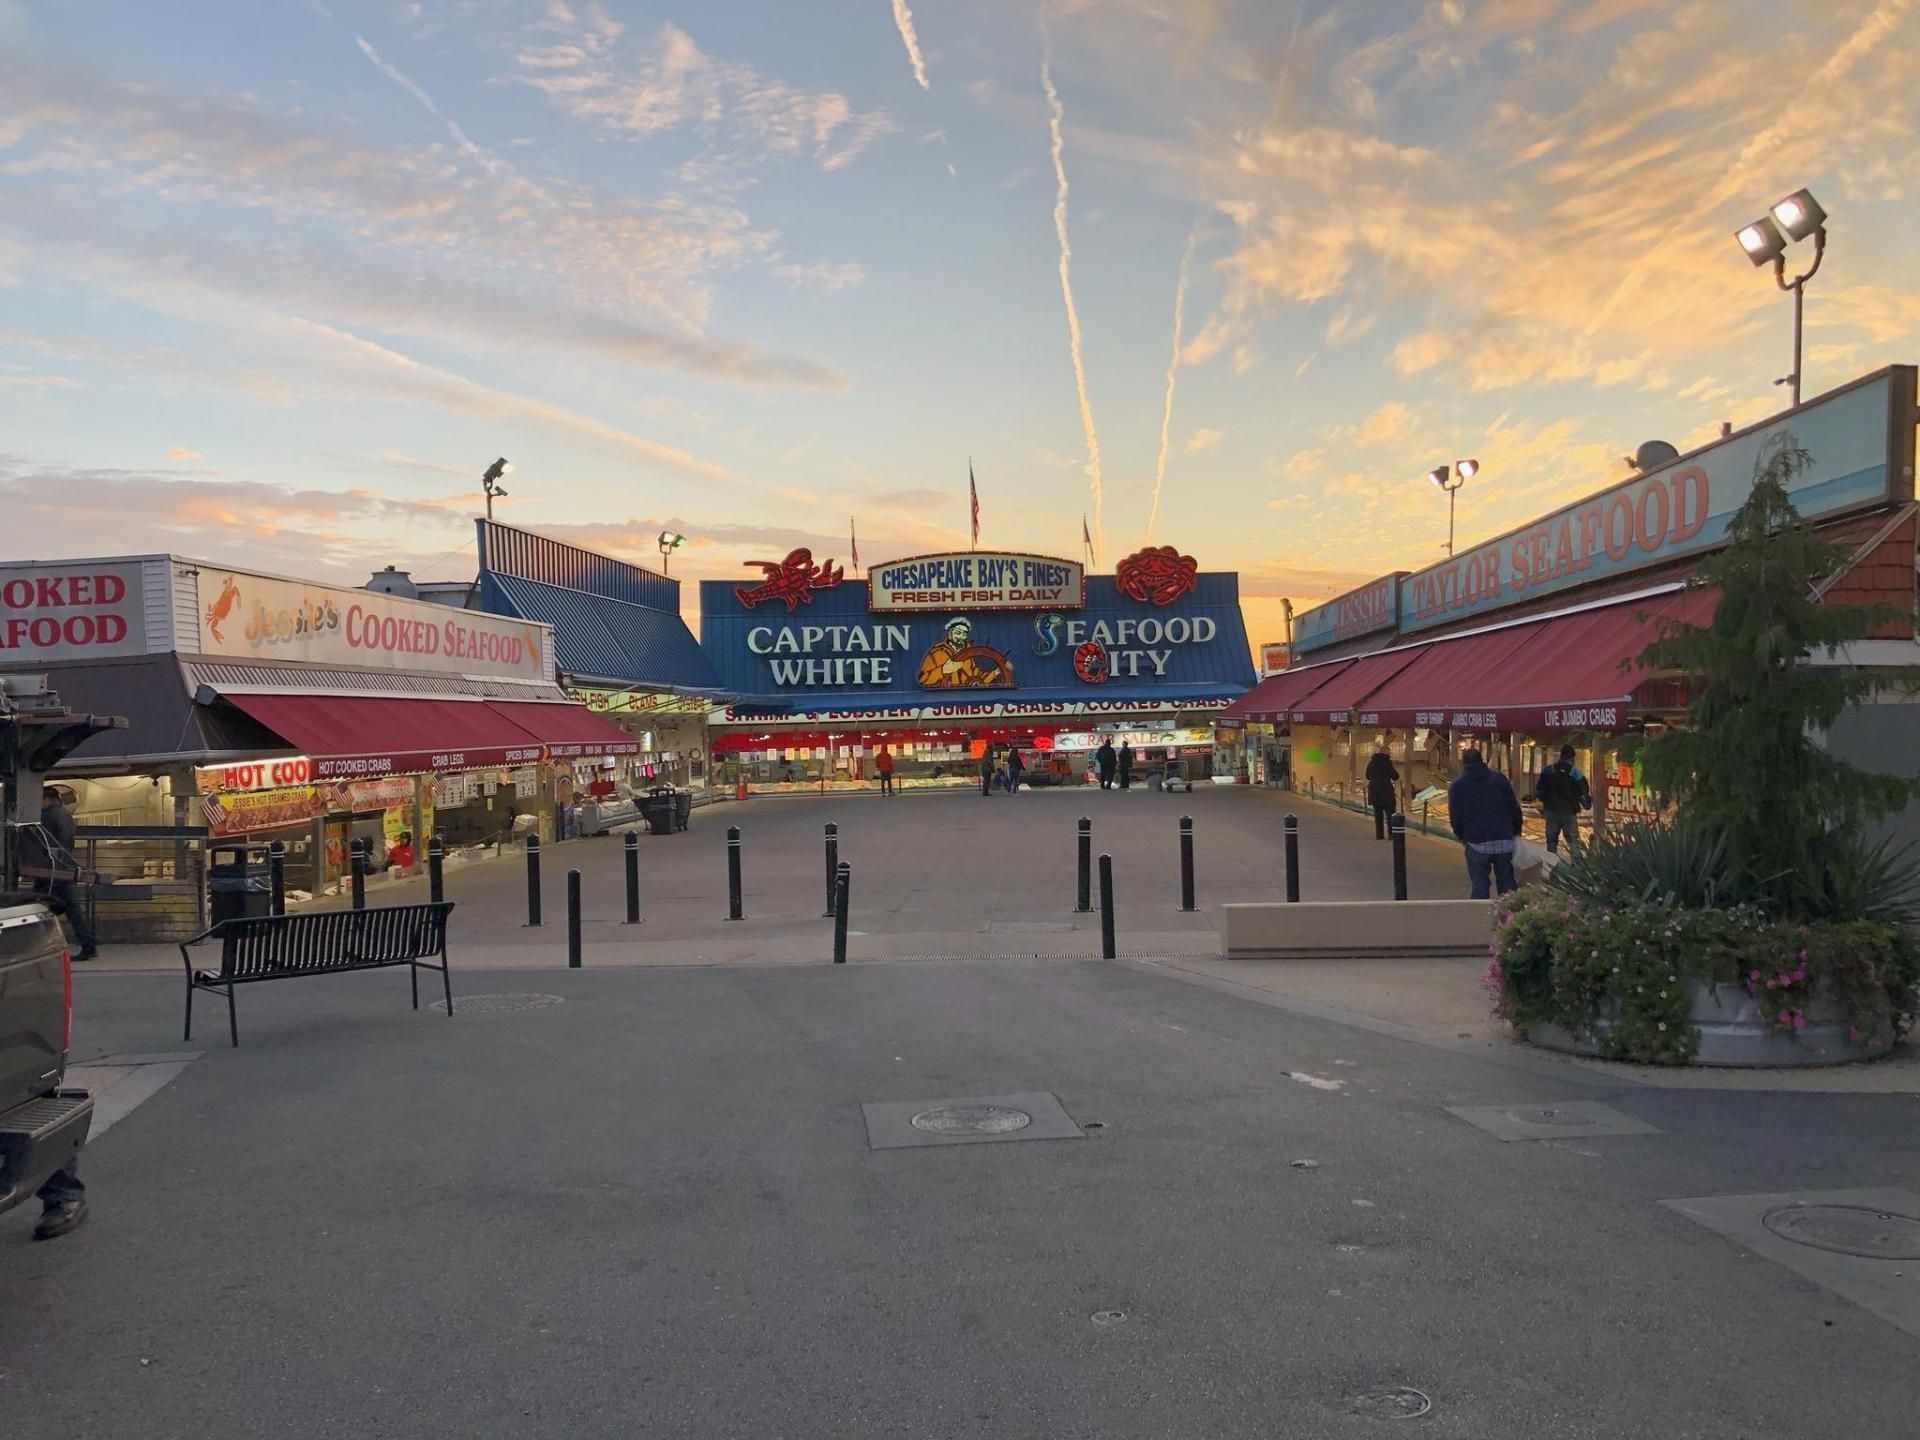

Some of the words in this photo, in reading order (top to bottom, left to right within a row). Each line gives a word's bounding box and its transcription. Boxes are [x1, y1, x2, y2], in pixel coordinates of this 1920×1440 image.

[1412, 548, 1500, 620] TAYLOR
[1510, 465, 1709, 592] SEAFOOD
[881, 560, 973, 590] CHESAPEAKE
[978, 559, 1018, 588] BAY'S
[1023, 561, 1071, 587] FINEST
[0, 575, 126, 609] OKED
[891, 591, 955, 603] FRESH
[960, 590, 1003, 602] FISH
[1008, 588, 1062, 601] DAILY
[1335, 586, 1387, 637] JESSIE
[443, 620, 522, 665] SEAFOOD
[746, 624, 911, 654] CAPTAIN
[769, 657, 893, 686] WHITE
[590, 692, 609, 709] FISH
[629, 695, 658, 710] CLAMS
[932, 703, 995, 717] JUMBO
[1004, 702, 1065, 714] CRABS
[1544, 711, 1560, 726] LIVE
[1561, 709, 1587, 726] JUMBO
[1589, 707, 1617, 726] CRABS
[1451, 713, 1468, 727] JUMBO
[1468, 713, 1483, 727] CRAB
[1483, 713, 1497, 728] LEGS
[1077, 732, 1115, 747] CRAB
[1122, 731, 1159, 745] SALE
[432, 755, 449, 767] CRAB
[449, 753, 465, 765] LEGS
[505, 750, 522, 761] SPICED
[223, 764, 265, 790] HOT
[271, 759, 309, 785] COO
[319, 761, 335, 775] HOT
[335, 759, 367, 774] COOKED
[367, 758, 391, 772] CRABS
[256, 795, 267, 804] HOT
